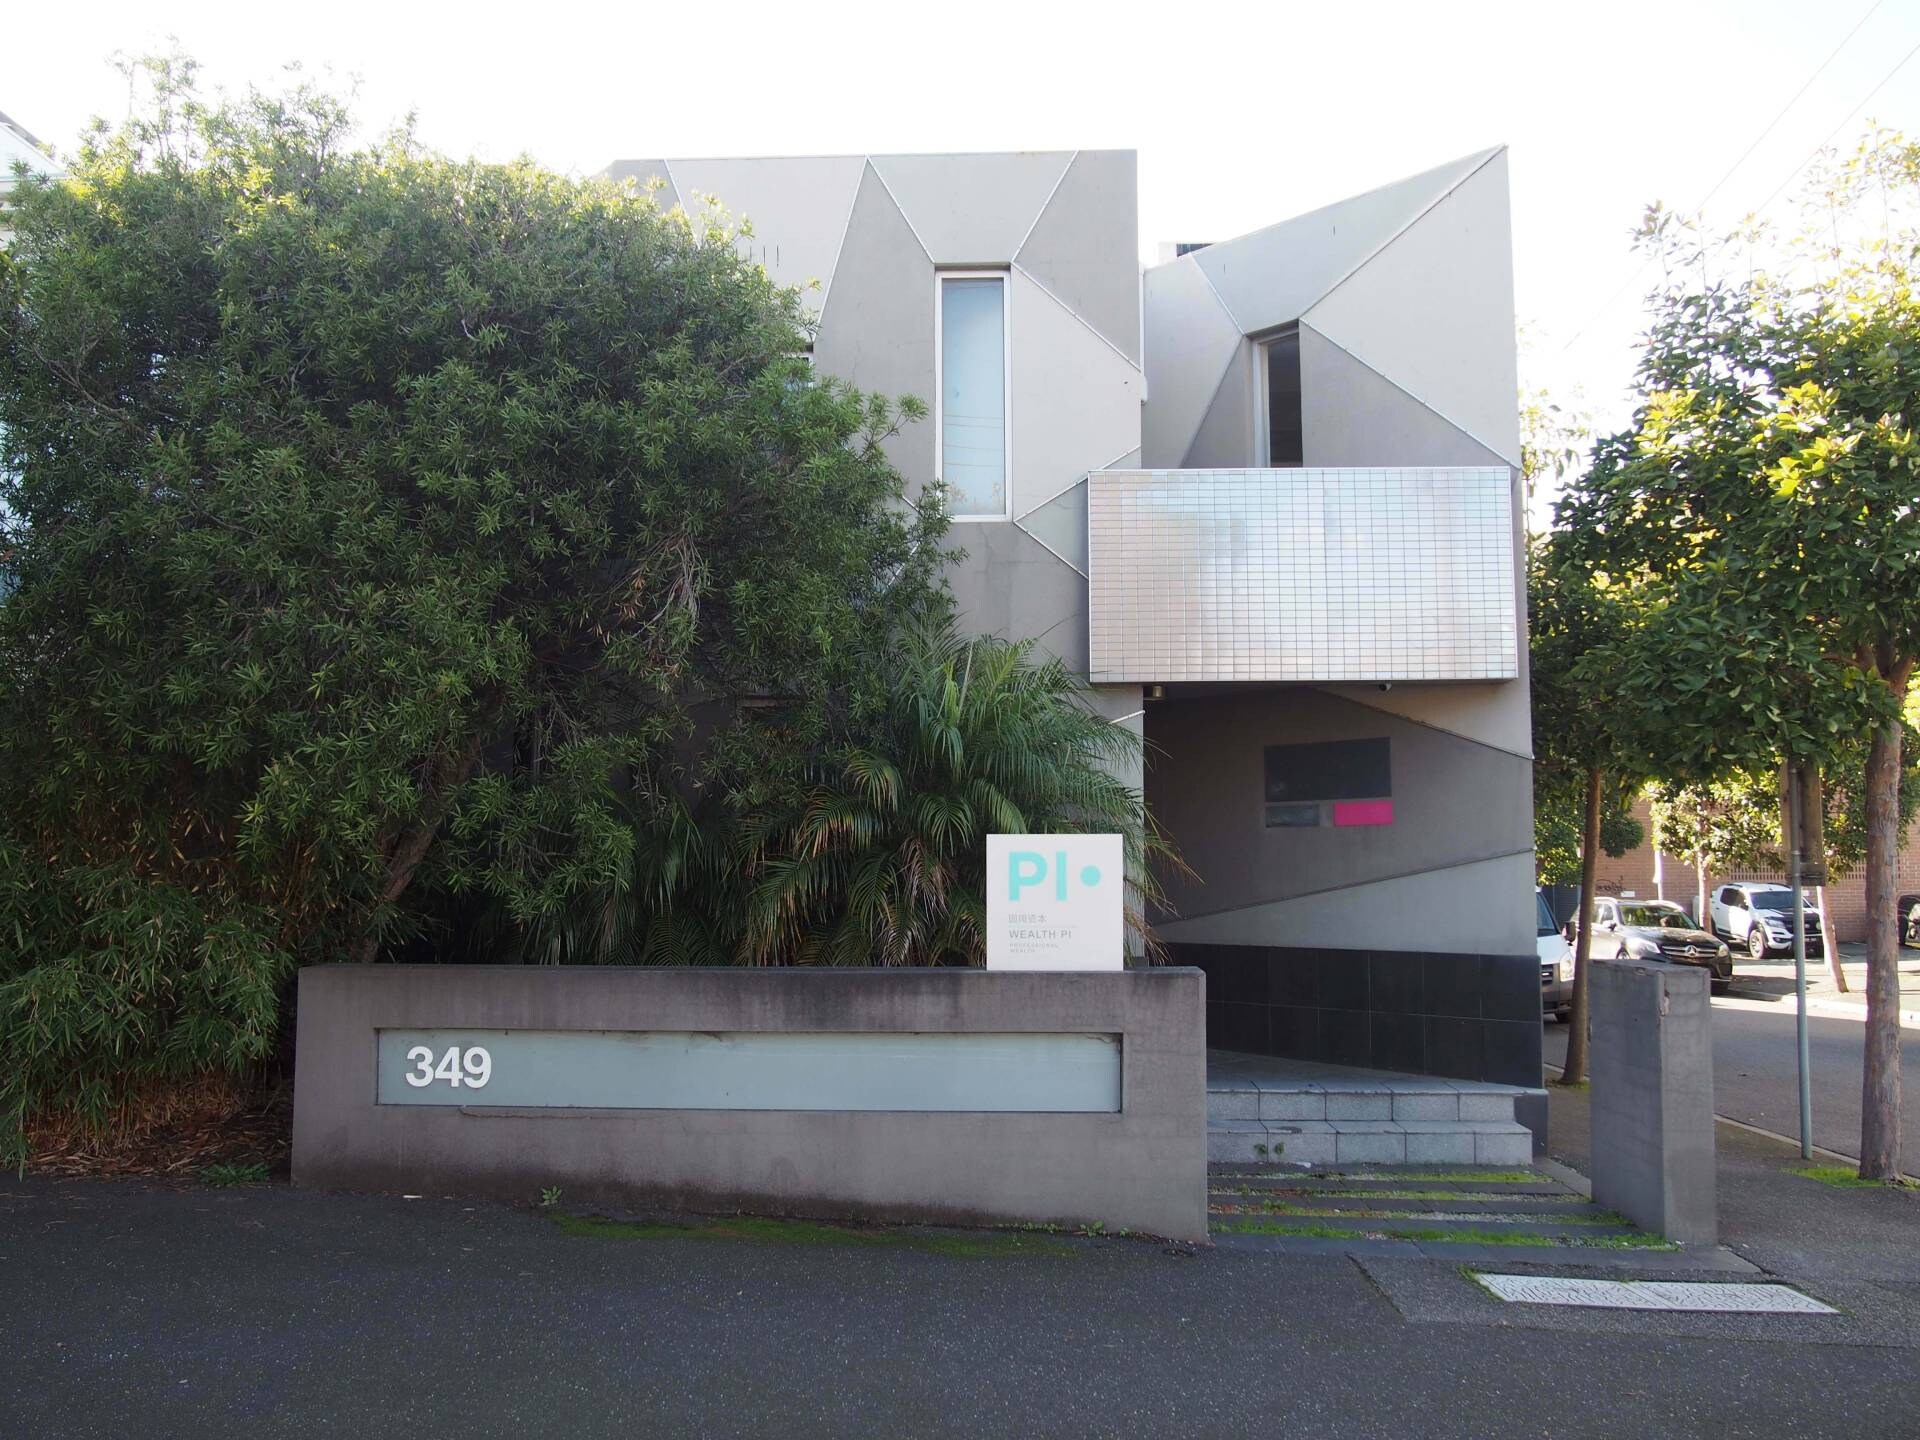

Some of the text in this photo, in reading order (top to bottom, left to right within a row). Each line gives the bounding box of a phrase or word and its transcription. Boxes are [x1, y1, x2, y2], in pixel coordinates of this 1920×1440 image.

[1009, 929, 1072, 939] WEALTH PI
[405, 1046, 492, 1089] 349
